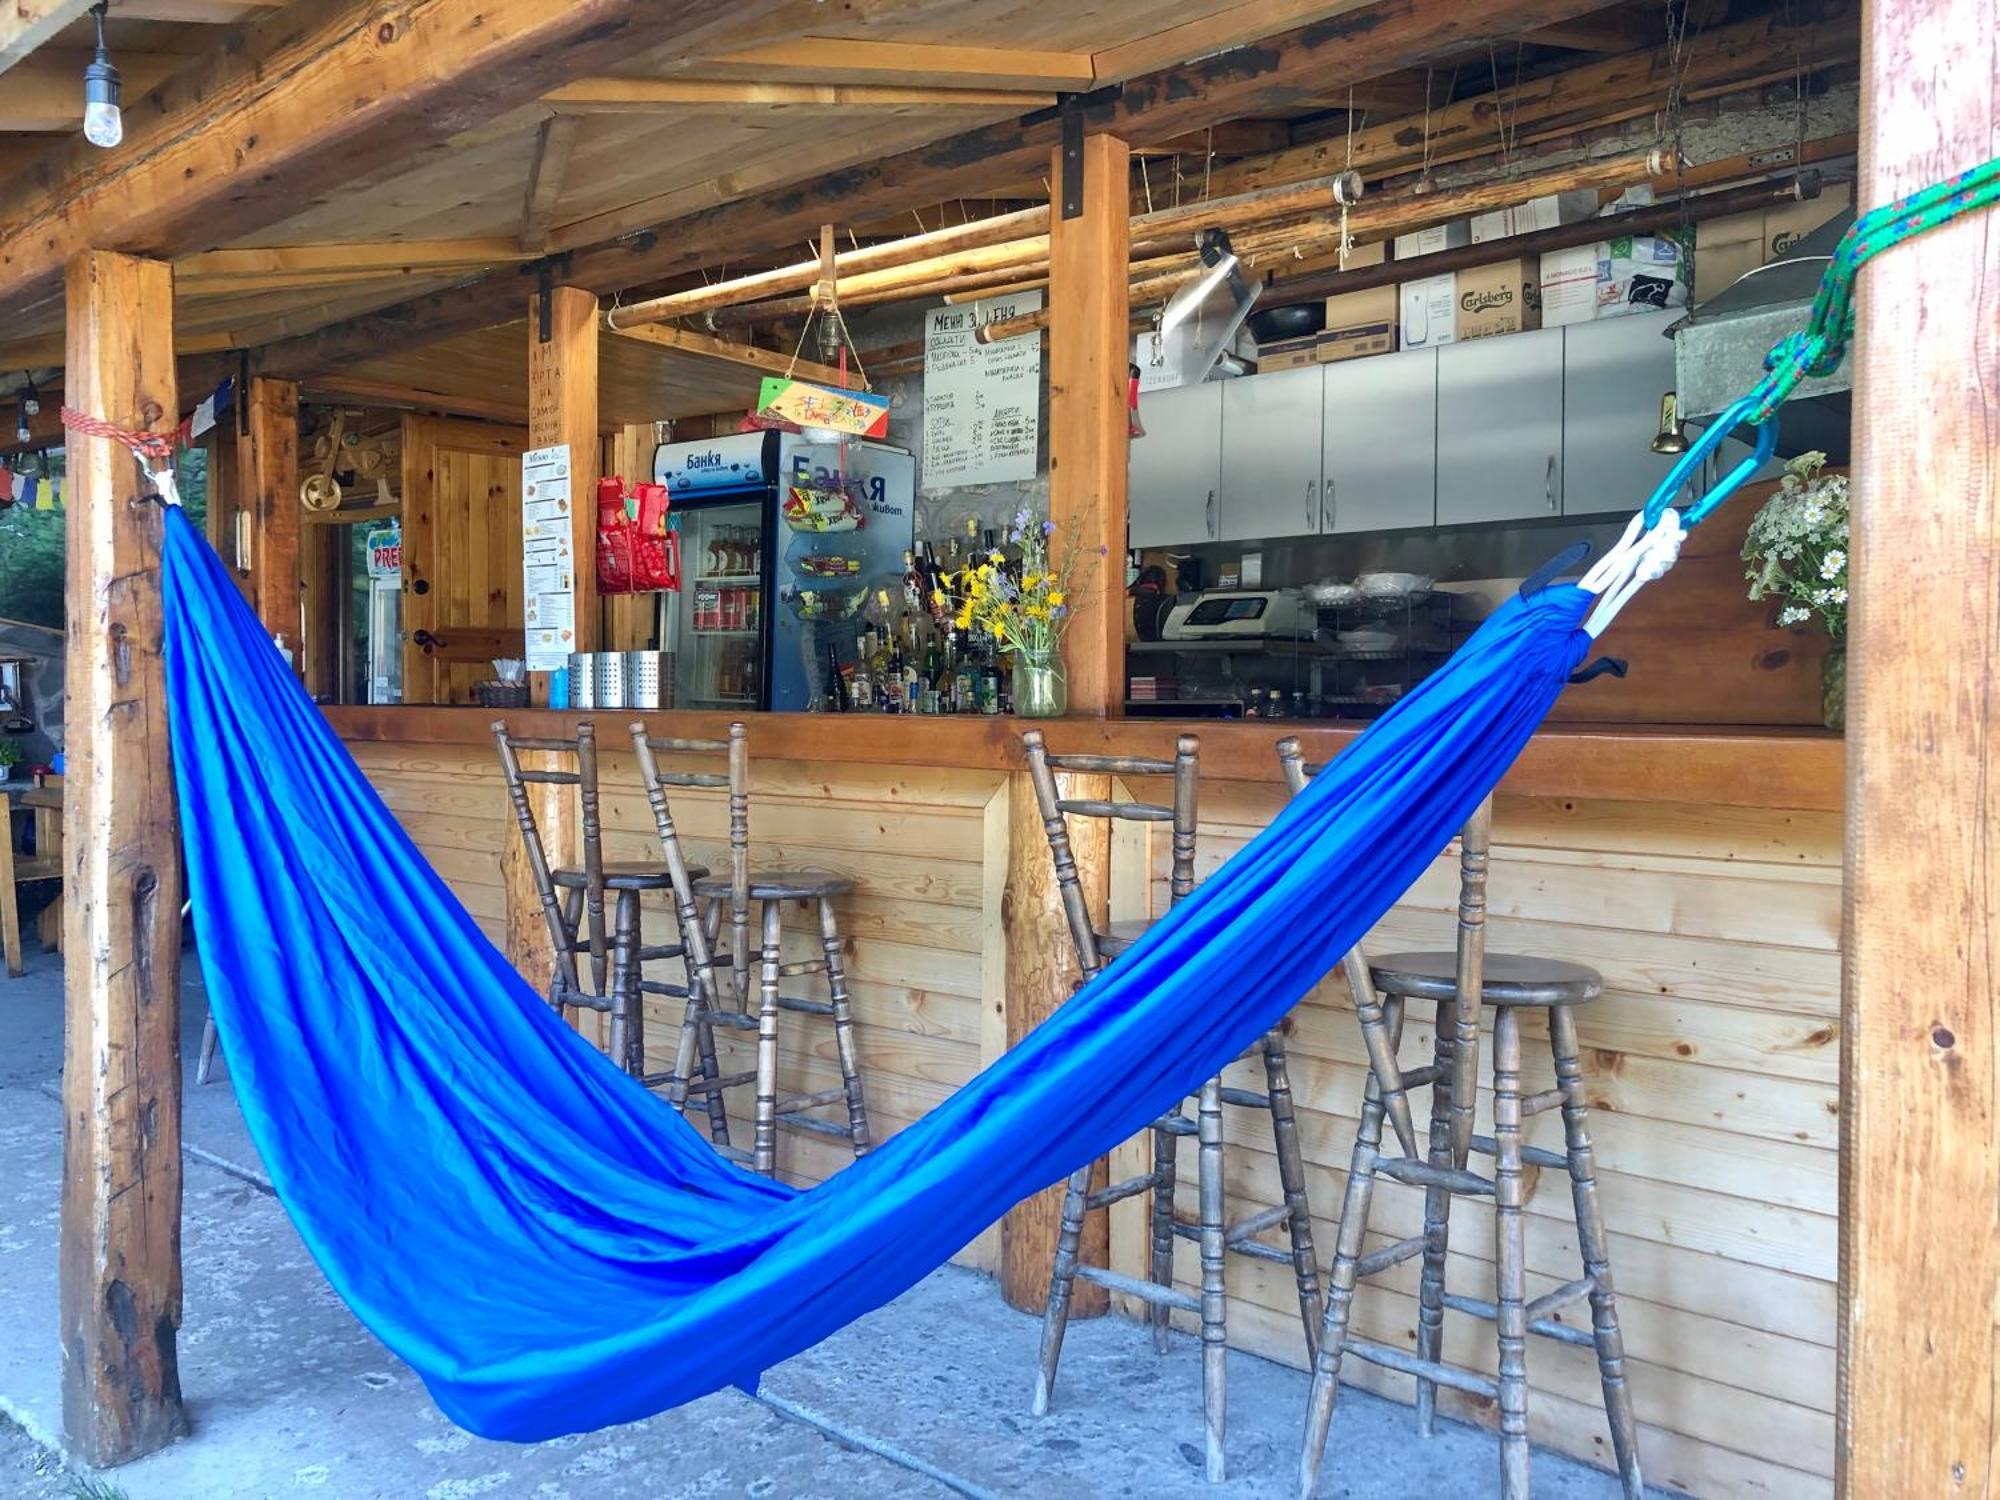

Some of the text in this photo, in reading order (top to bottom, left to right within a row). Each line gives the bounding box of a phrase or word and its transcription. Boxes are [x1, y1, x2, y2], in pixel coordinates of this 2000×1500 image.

[1461, 289, 1513, 312] Carlsberg
[686, 449, 721, 469] Банкя
[374, 547, 403, 569] PRE
